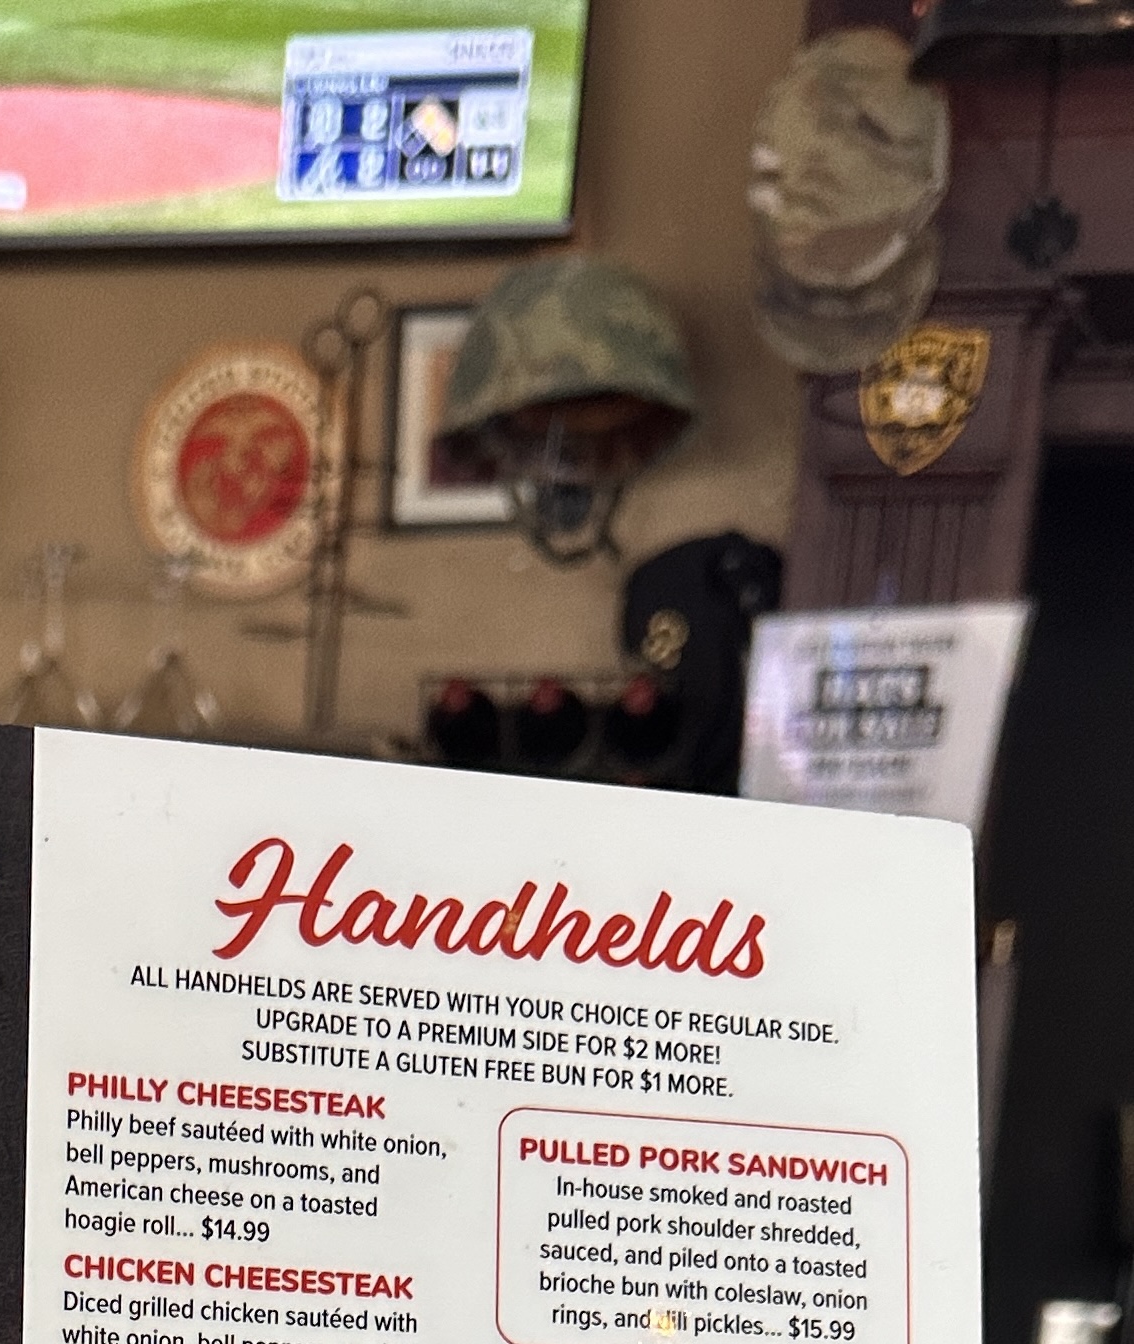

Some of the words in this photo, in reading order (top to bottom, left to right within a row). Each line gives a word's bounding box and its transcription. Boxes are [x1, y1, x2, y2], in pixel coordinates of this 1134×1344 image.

[211, 837, 766, 979] Handhelds
[256, 1007, 357, 1036] UPGRADE
[363, 1017, 391, 1039] TO
[397, 1020, 412, 1041] A
[418, 1021, 516, 1049] PREMIUM
[522, 1030, 569, 1053] SIDE
[575, 1034, 617, 1057] FOR
[623, 1035, 648, 1060] $2
[655, 1040, 721, 1065] MORE!
[68, 1072, 168, 1103] PHILLY
[177, 1081, 386, 1120] CHEESESTEAK
[520, 1137, 630, 1168] PULLED
[639, 1146, 720, 1174] PORK
[728, 1152, 887, 1186] SANDWICH
